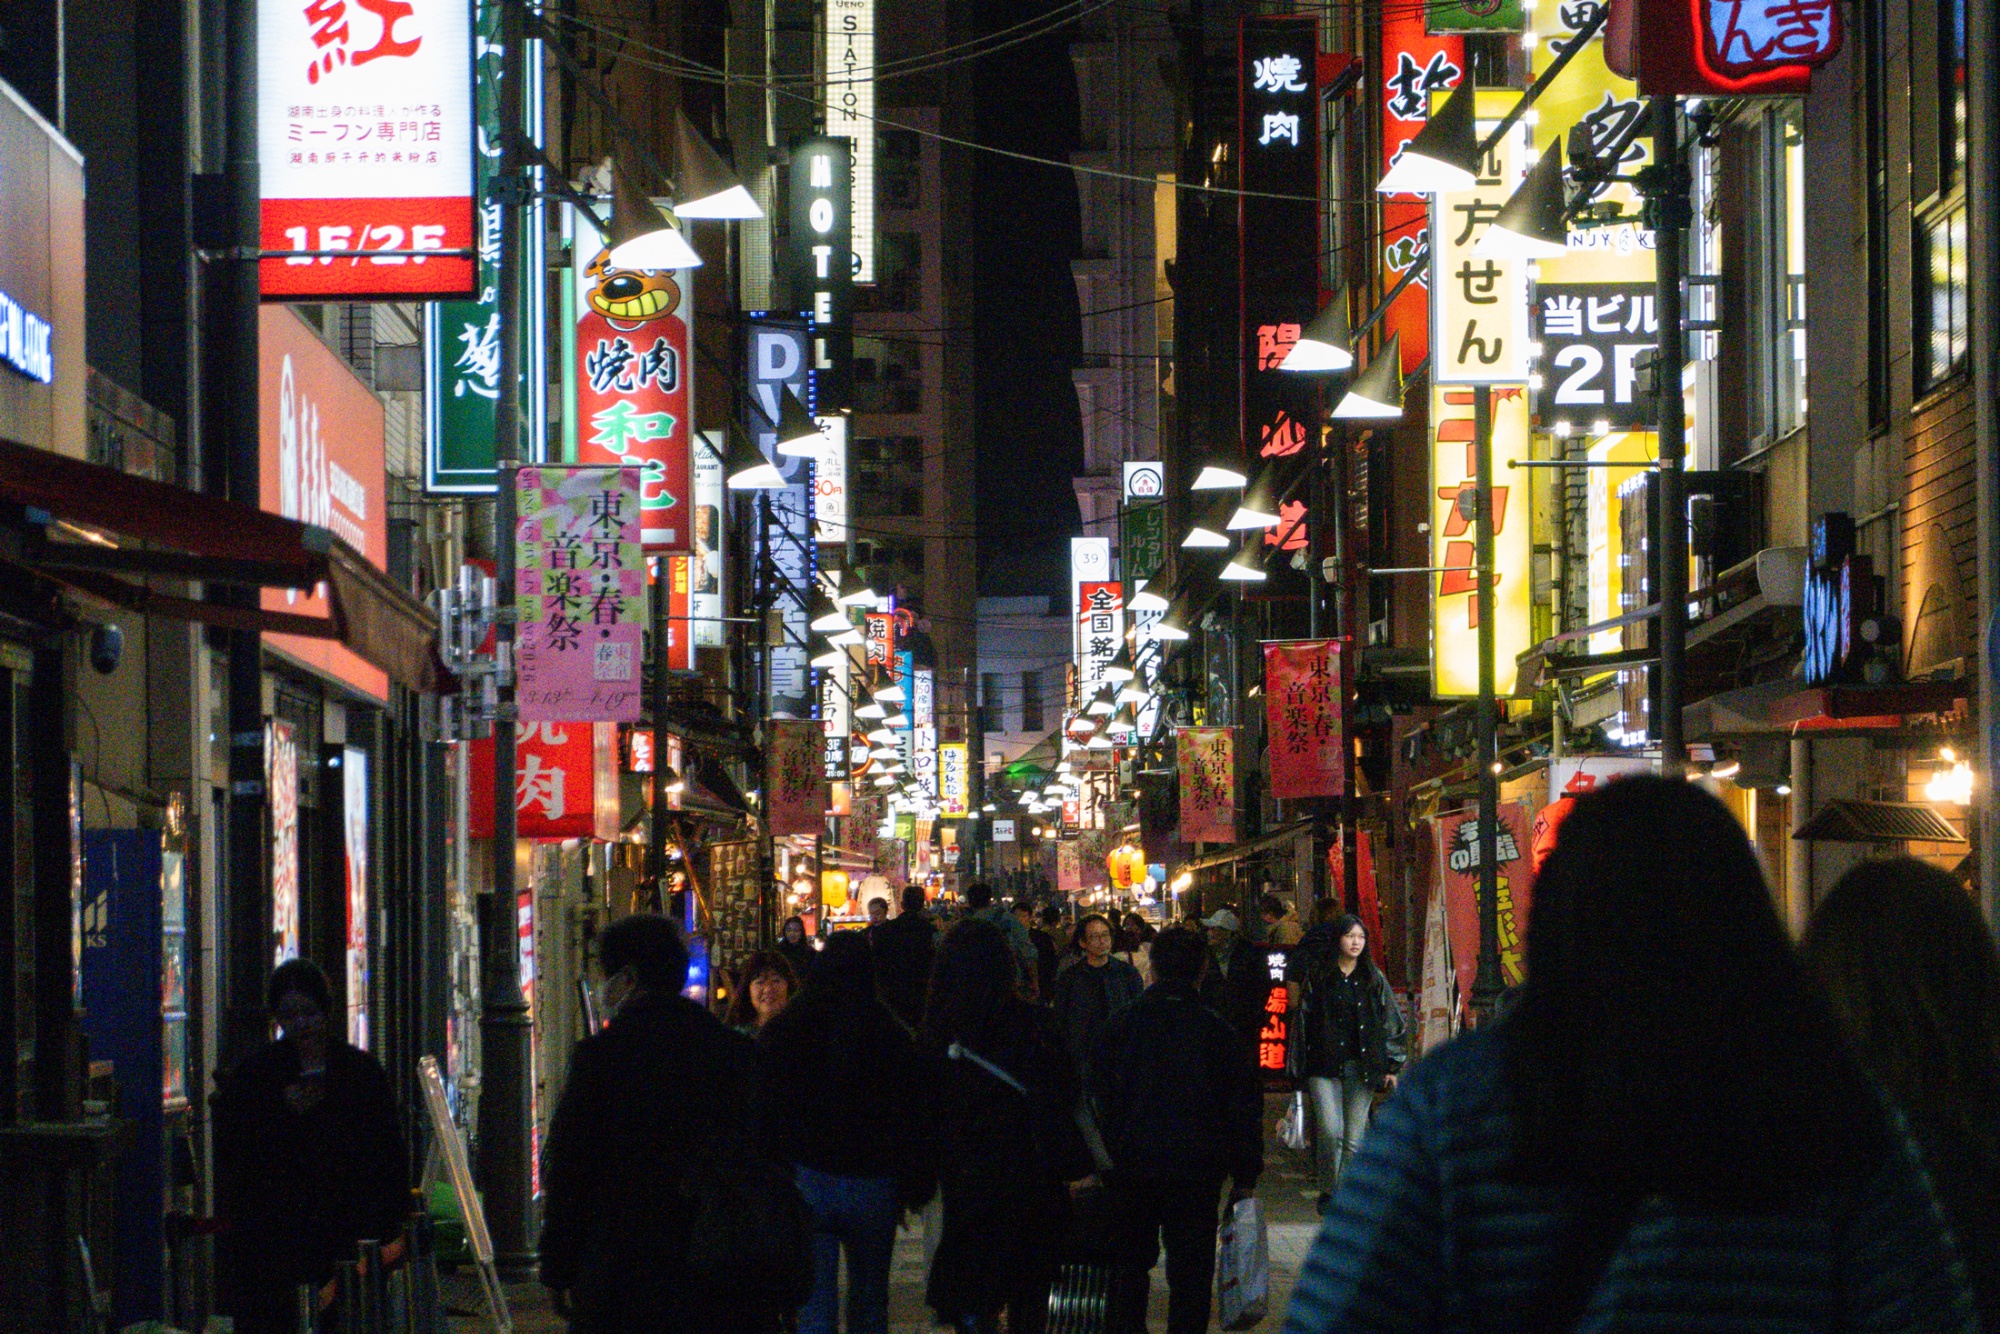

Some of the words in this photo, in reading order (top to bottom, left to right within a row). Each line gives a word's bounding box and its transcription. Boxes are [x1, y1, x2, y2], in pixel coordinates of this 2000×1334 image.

[843, 15, 858, 122] STATION
[1253, 54, 1307, 146] 焼肉
[288, 121, 441, 142] ミーフン専門店
[285, 224, 446, 267] 1F/2F
[809, 154, 834, 370] HOTEL
[586, 338, 680, 393] 焼肉
[547, 531, 582, 651] 音楽祭
[866, 618, 886, 662] 焼肉
[1087, 588, 1115, 699] 全国銘酒
[1286, 681, 1309, 755] 音楽祭
[1192, 758, 1210, 811] 音楽祭
